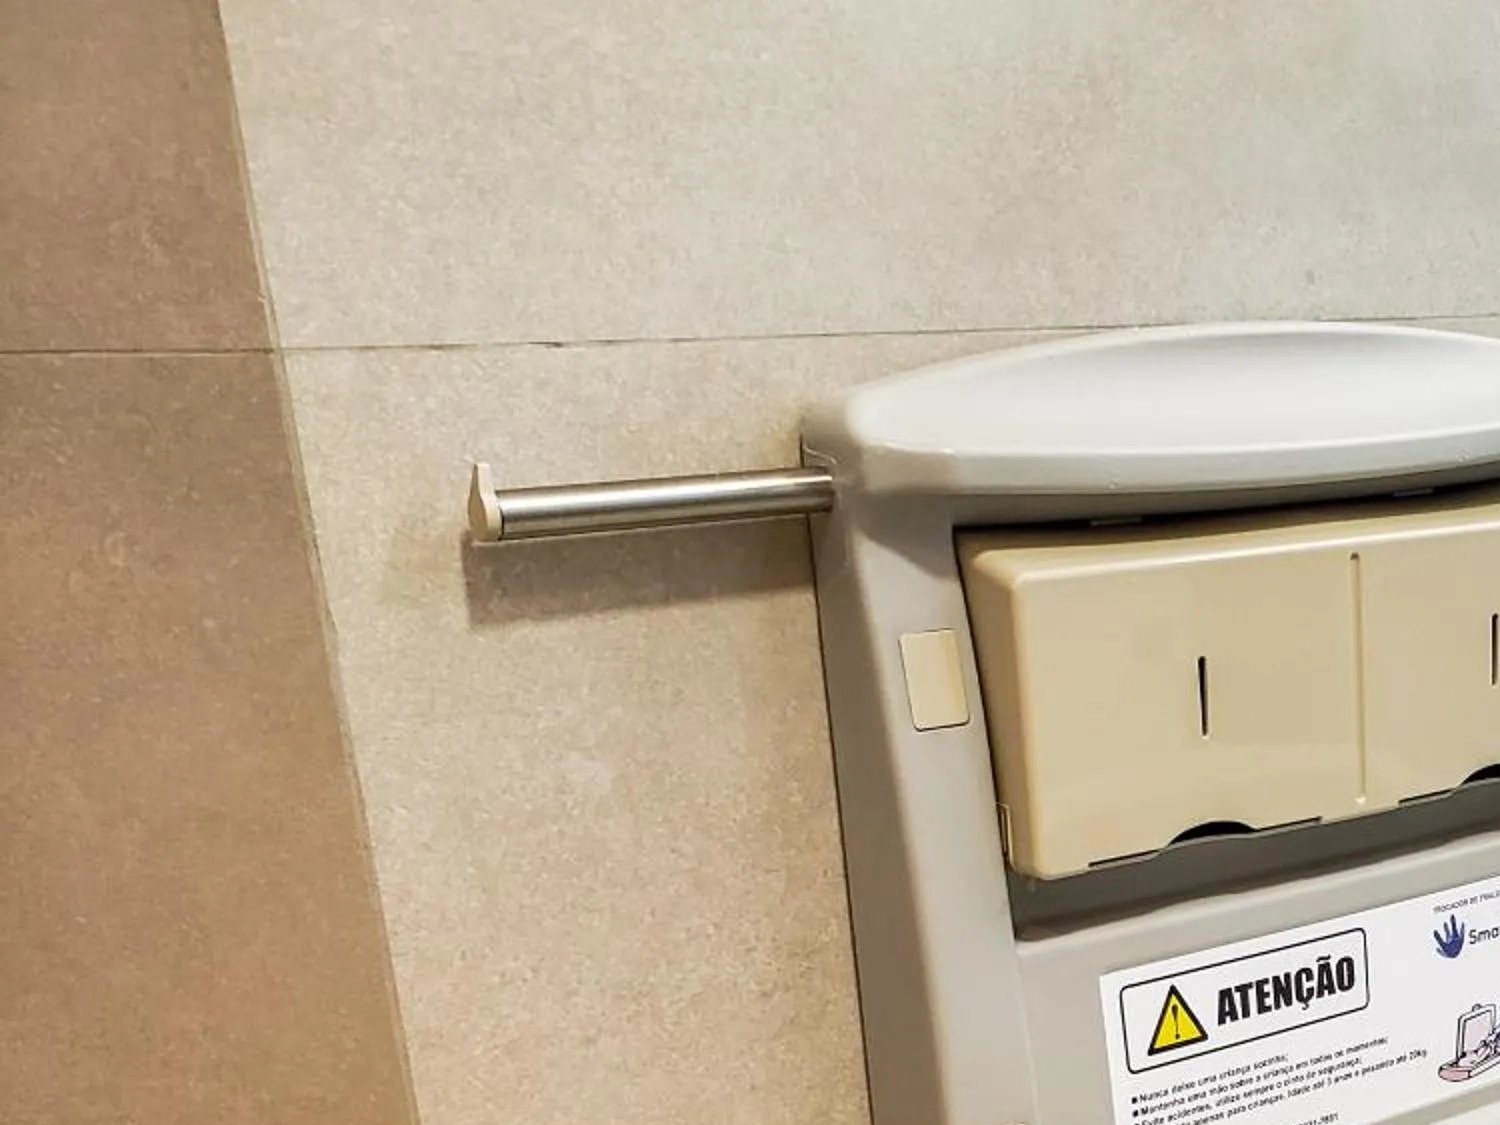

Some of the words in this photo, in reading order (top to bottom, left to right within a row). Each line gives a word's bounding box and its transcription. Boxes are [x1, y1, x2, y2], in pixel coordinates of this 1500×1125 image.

[1217, 954, 1356, 1027] ATENÇÃO
[1139, 1089, 1169, 1102] Nunca
[1198, 1075, 1217, 1086] uma
[1219, 1065, 1250, 1080] criança
[1227, 1106, 1246, 1118] para
